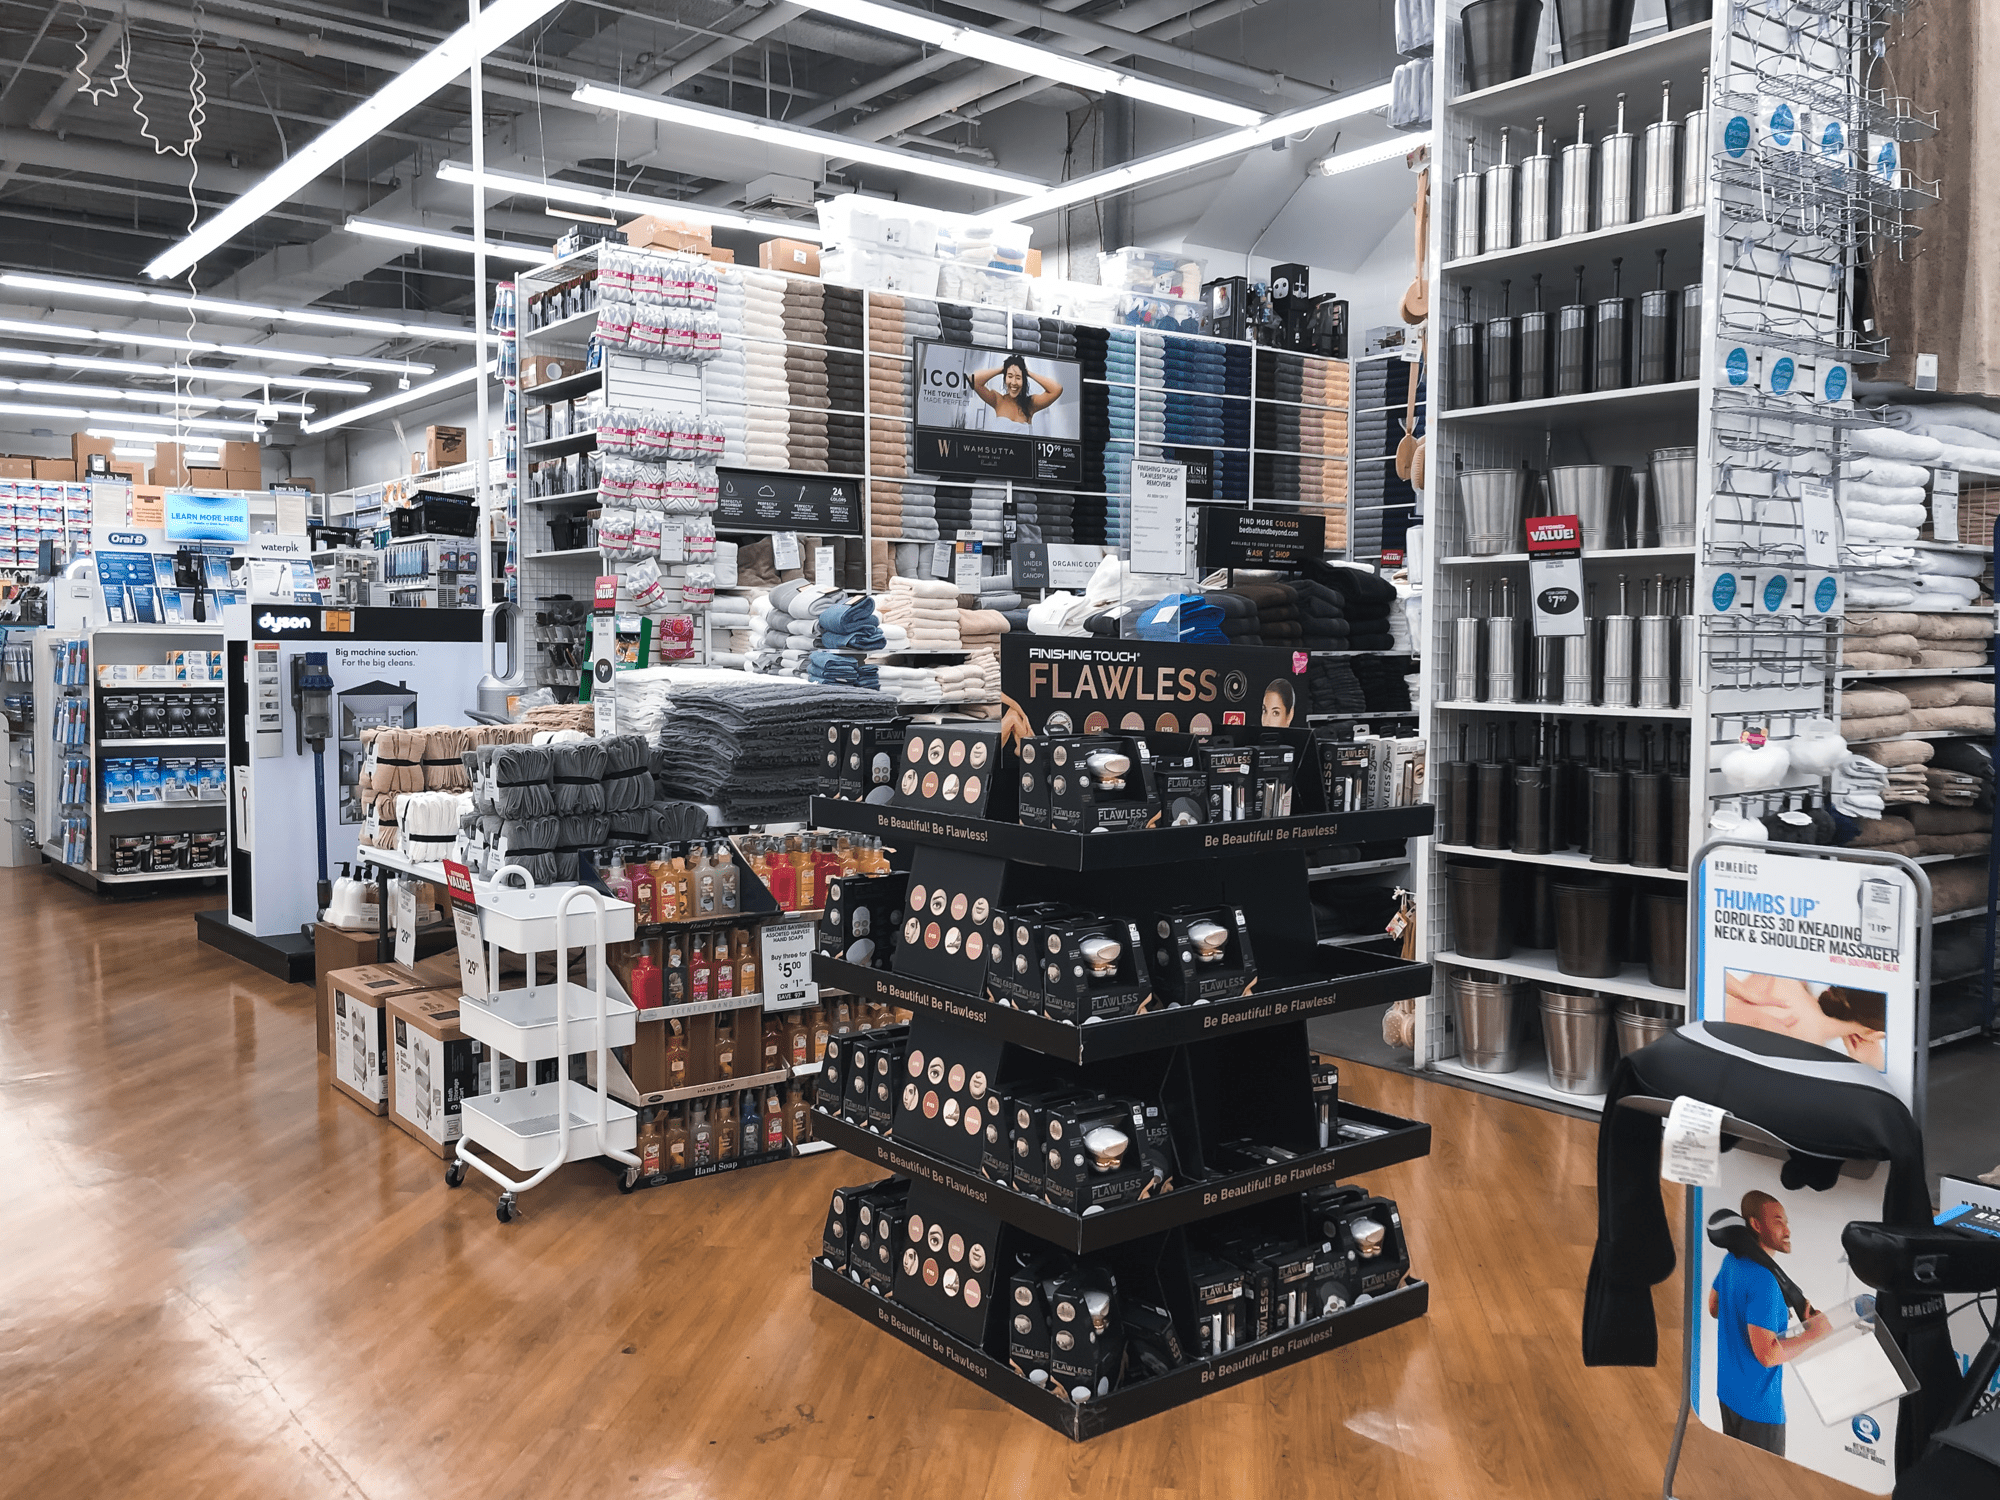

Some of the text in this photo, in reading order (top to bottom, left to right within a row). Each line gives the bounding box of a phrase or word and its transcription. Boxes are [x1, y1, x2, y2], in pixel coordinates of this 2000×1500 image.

[923, 368, 975, 390] ICON
[943, 398, 970, 406] PERFECT
[963, 445, 1014, 455] WAMSUTTA
[91, 472, 105, 480] how
[114, 474, 127, 482] buy
[1137, 465, 1161, 473] FINISHING
[833, 487, 842, 496] 24
[111, 534, 145, 544] Oral-B
[1239, 526, 1298, 537] bedbathandbeyond.com
[1530, 528, 1574, 542] VALUE!
[261, 541, 299, 553] waterpik
[259, 612, 311, 633] dyson
[336, 648, 349, 657] Big
[350, 648, 386, 656] machine
[1029, 648, 1092, 661] FINISHING
[373, 659, 386, 668] big
[1029, 662, 1218, 702] FLAWLESS
[1098, 808, 1148, 820] FLAWLESS
[878, 814, 988, 842] Be Beautiful! Be Flawless!
[1204, 824, 1338, 848] Be Beautiful! Be Flawless!
[448, 874, 471, 892] VALUE!
[1714, 888, 1785, 915] THUMBS
[690, 919, 732, 930] Hand Soap
[1715, 910, 1861, 941] CORDLESS 3D KNEADING
[1714, 925, 1900, 963] NECK & SHOULDER MASSAGER
[1848, 958, 1881, 970] SOOTHING
[671, 1004, 708, 1016] SCENTED
[712, 1000, 734, 1011] HAND
[876, 980, 987, 1022] Be Beautiful! Be Flawless!
[1092, 994, 1138, 1010] FLAWLESS
[1204, 993, 1336, 1028] Be Beautiful! Be Flawless!
[697, 1083, 735, 1094] HAND SOAP
[694, 1166, 716, 1176] Hand
[718, 1161, 738, 1172] Soap
[878, 1147, 988, 1203] Be Beautiful! Be Flawless!
[1092, 1179, 1142, 1200] FLAWLESS
[1204, 1159, 1336, 1204] Be Beautiful! Be Flawless!
[878, 1308, 988, 1378] Be Beautiful! Be Flawless!
[1201, 1327, 1333, 1383] Be Beautiful! Be Flawless!
